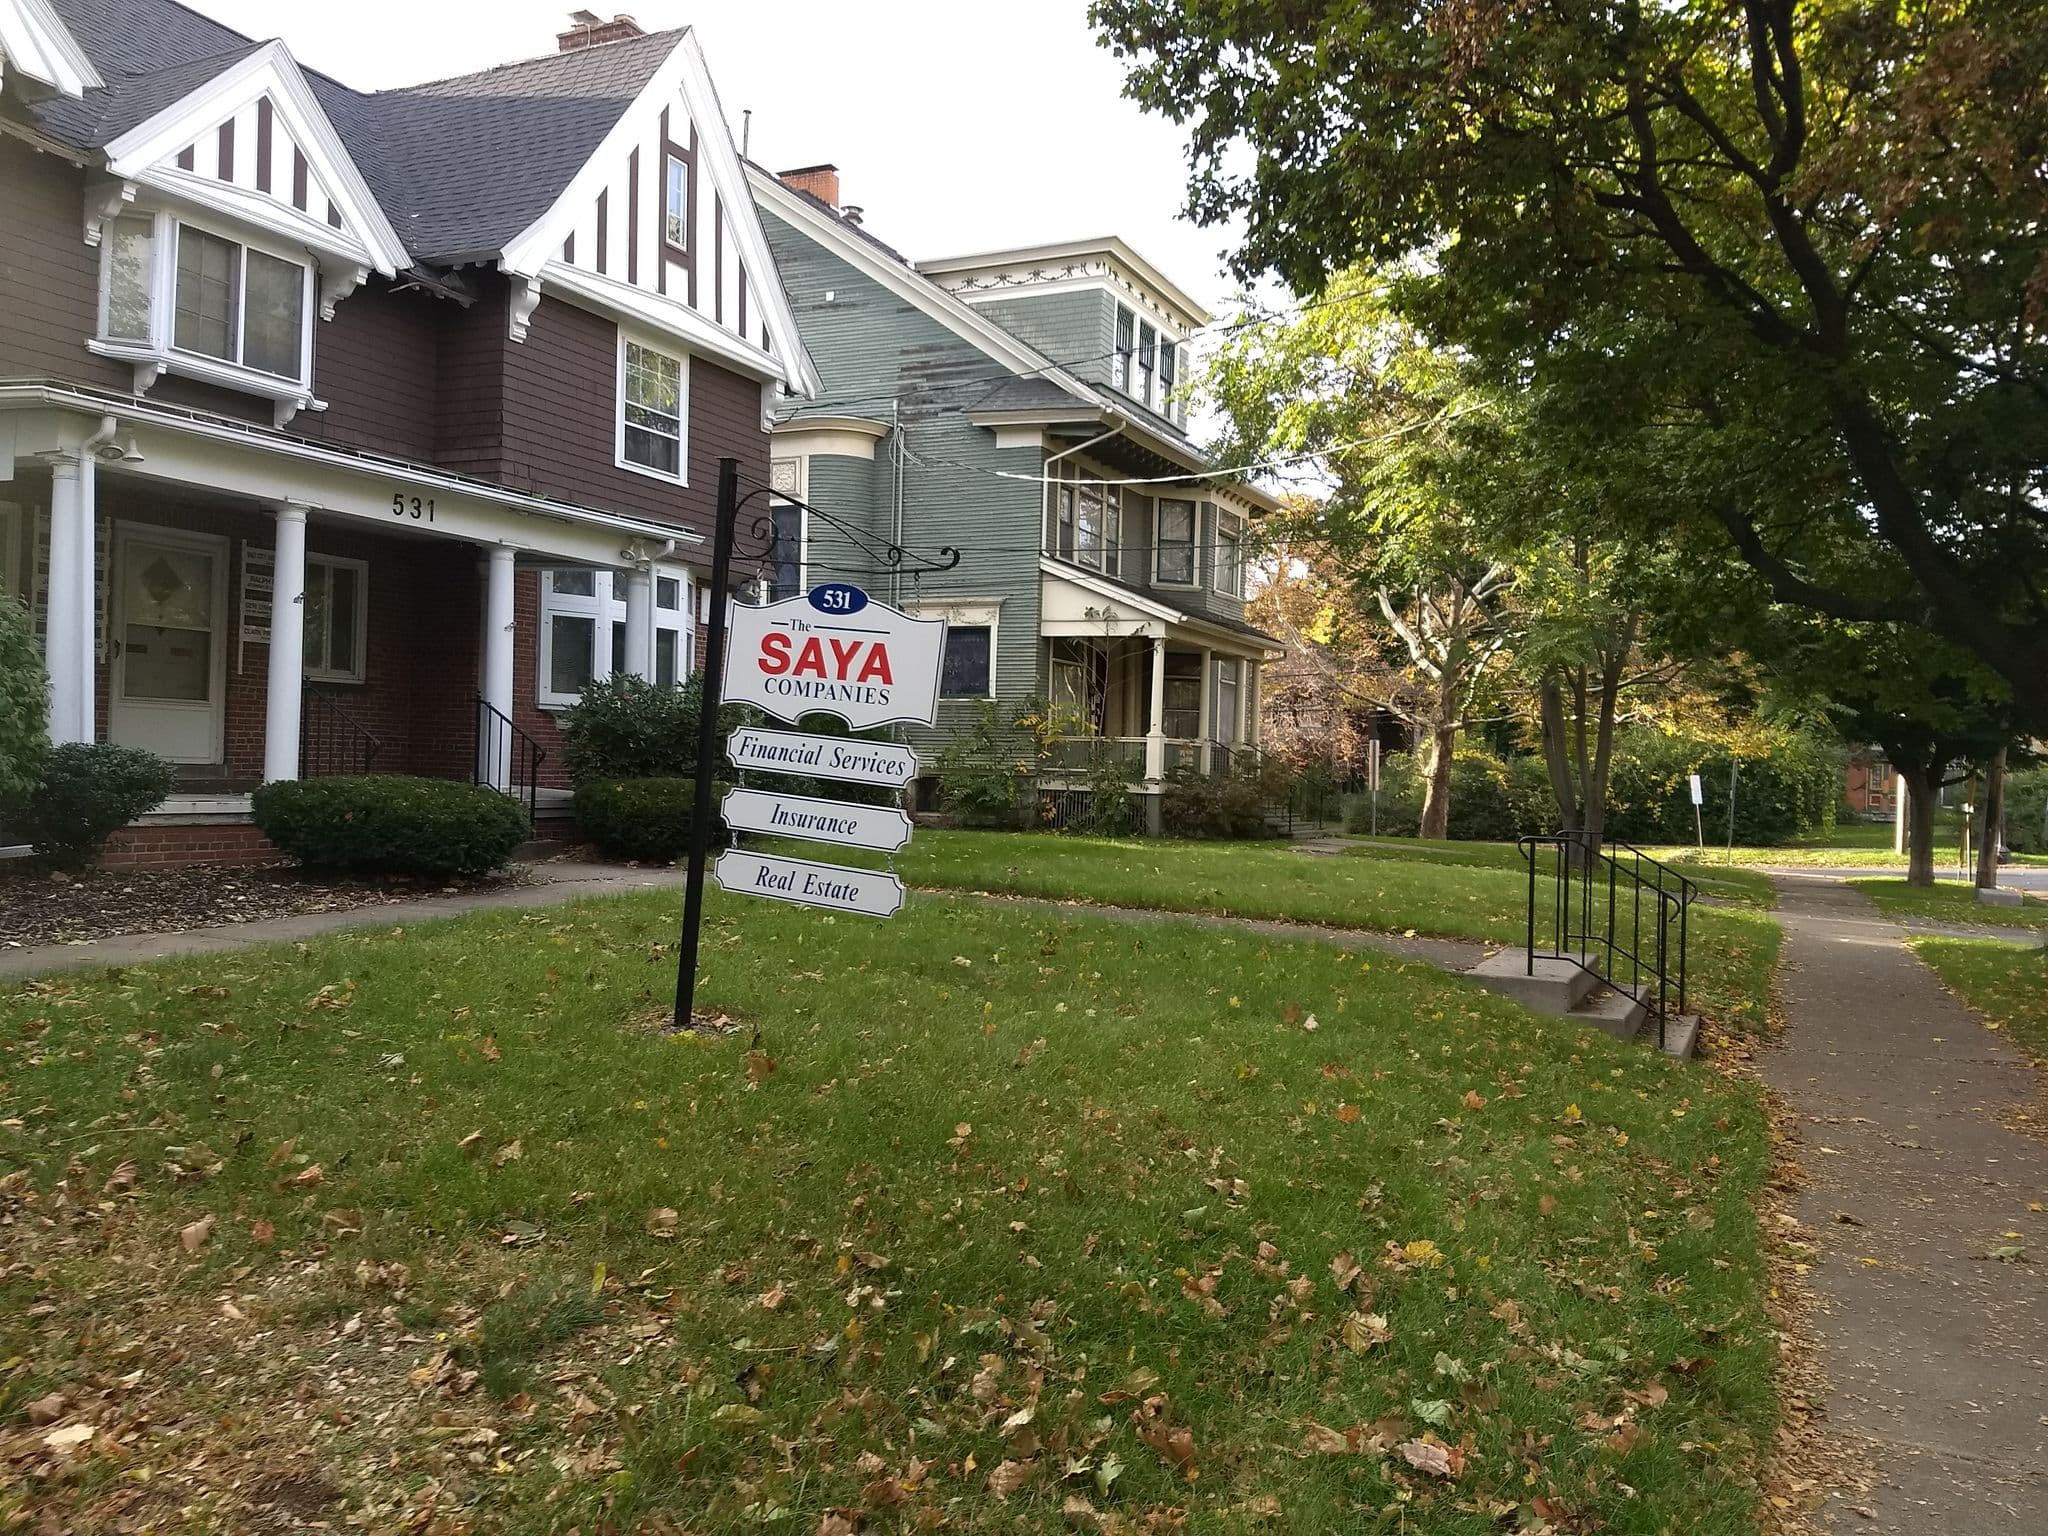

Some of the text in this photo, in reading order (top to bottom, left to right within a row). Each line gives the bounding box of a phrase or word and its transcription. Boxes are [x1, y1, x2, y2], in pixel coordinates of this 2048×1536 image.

[392, 493, 435, 522] 531
[822, 590, 851, 610] 531
[790, 618, 812, 633] The
[758, 632, 893, 685] SAYA
[764, 677, 890, 706] COMPANIES
[738, 735, 906, 777] Financial Services
[770, 803, 857, 835] Insurance
[755, 865, 859, 902] Real Estate
